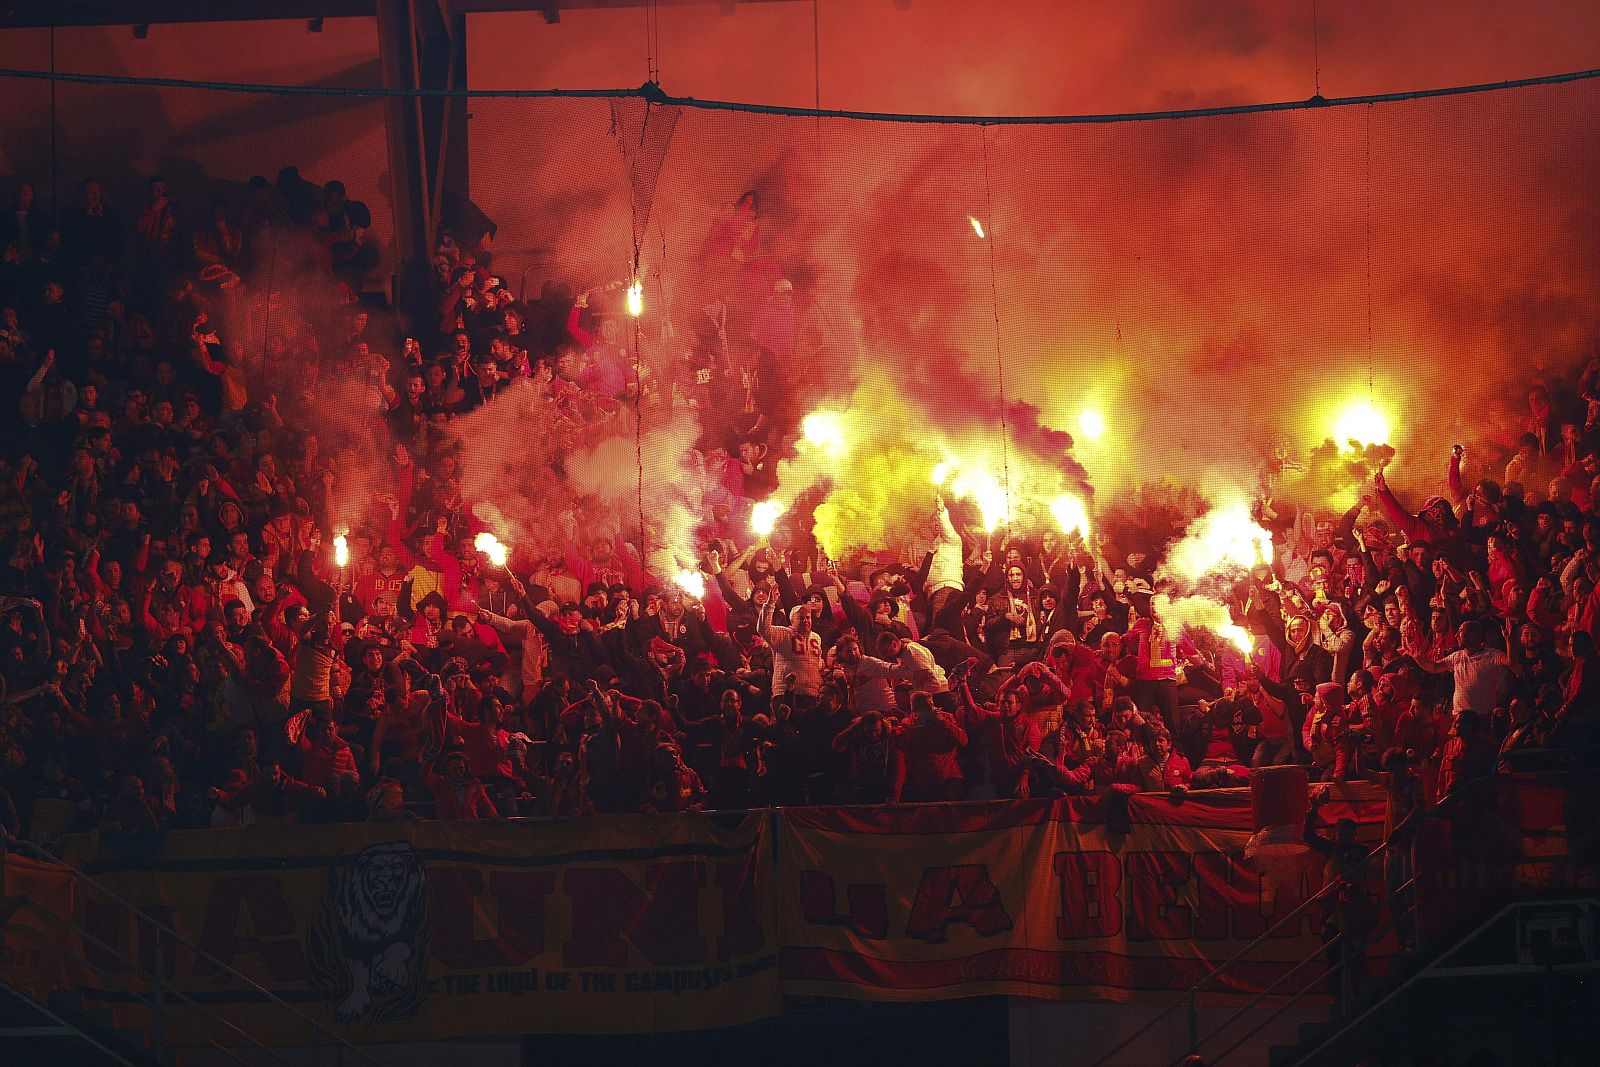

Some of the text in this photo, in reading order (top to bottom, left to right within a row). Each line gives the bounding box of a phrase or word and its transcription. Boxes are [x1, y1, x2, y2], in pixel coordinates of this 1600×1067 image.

[443, 974, 481, 995] THE
[545, 971, 571, 992] OF
[577, 971, 618, 993] THE
